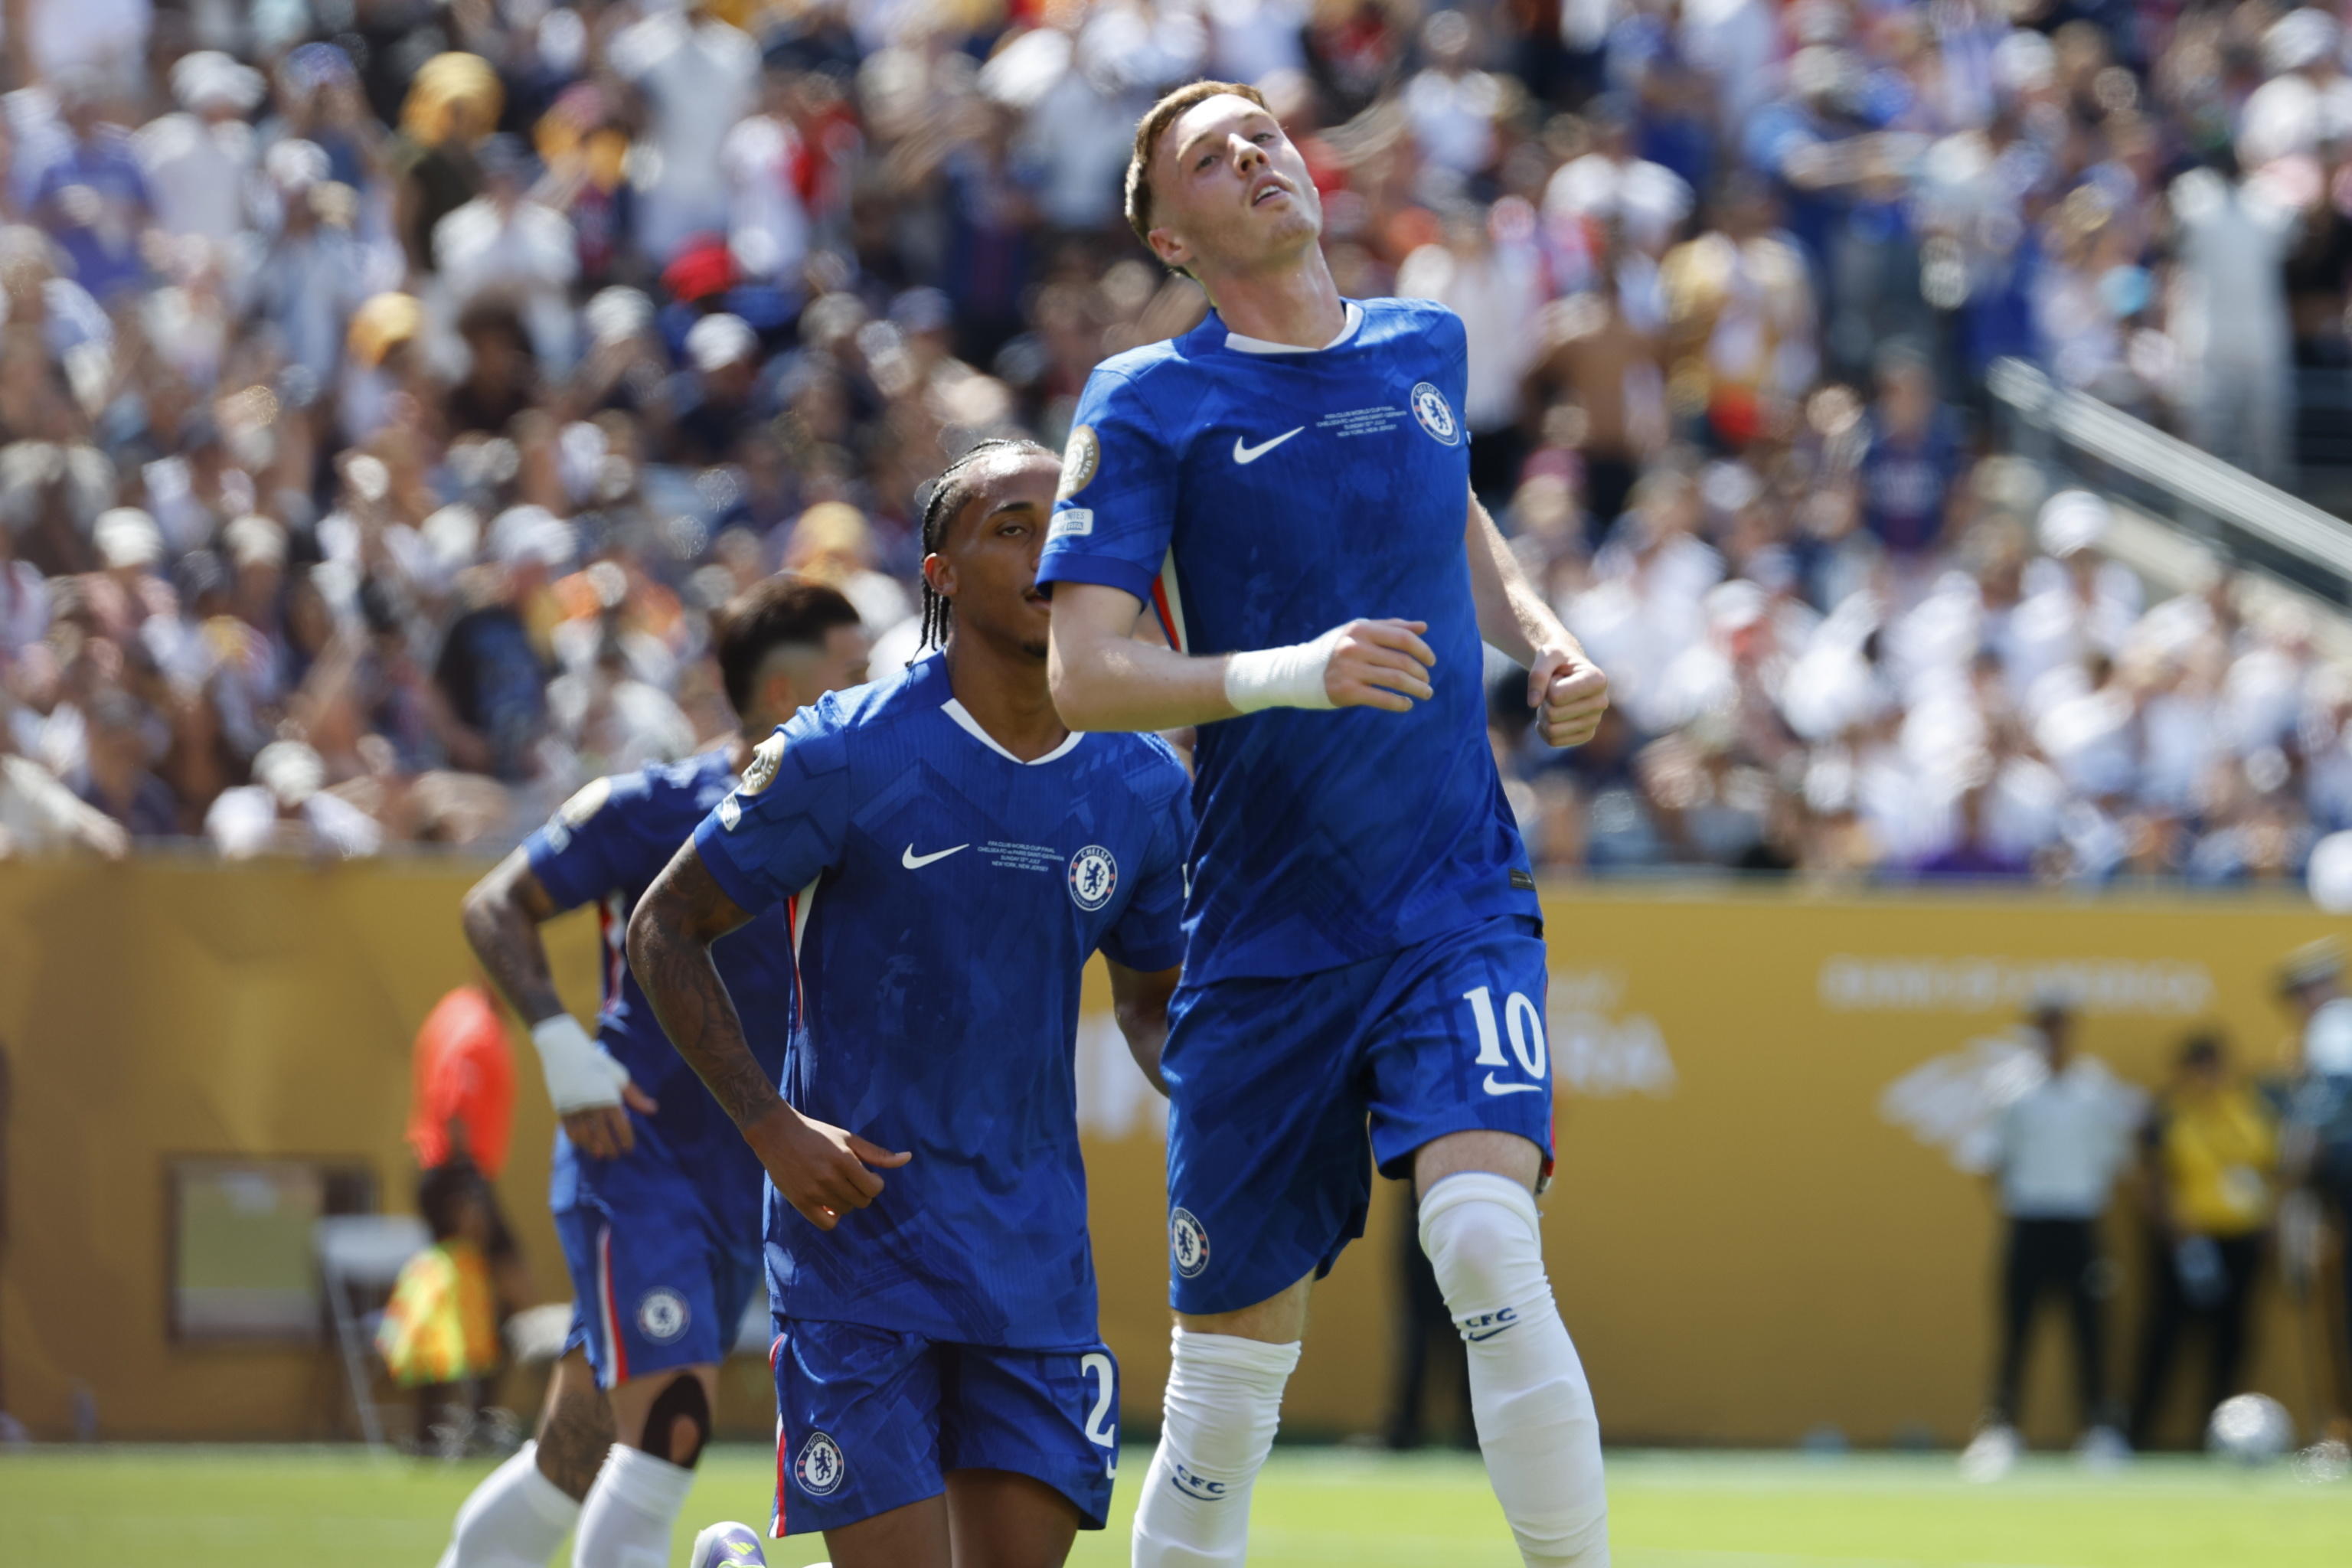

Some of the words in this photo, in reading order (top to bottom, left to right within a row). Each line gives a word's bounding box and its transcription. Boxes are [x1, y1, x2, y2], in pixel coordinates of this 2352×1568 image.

[1080, 848, 1112, 866] CHELSEA
[1463, 985, 1546, 1080] 10
[1465, 1307, 1518, 1328] CFC
[805, 1434, 829, 1453] CHELSEA
[1177, 1464, 1226, 1494] CFC
